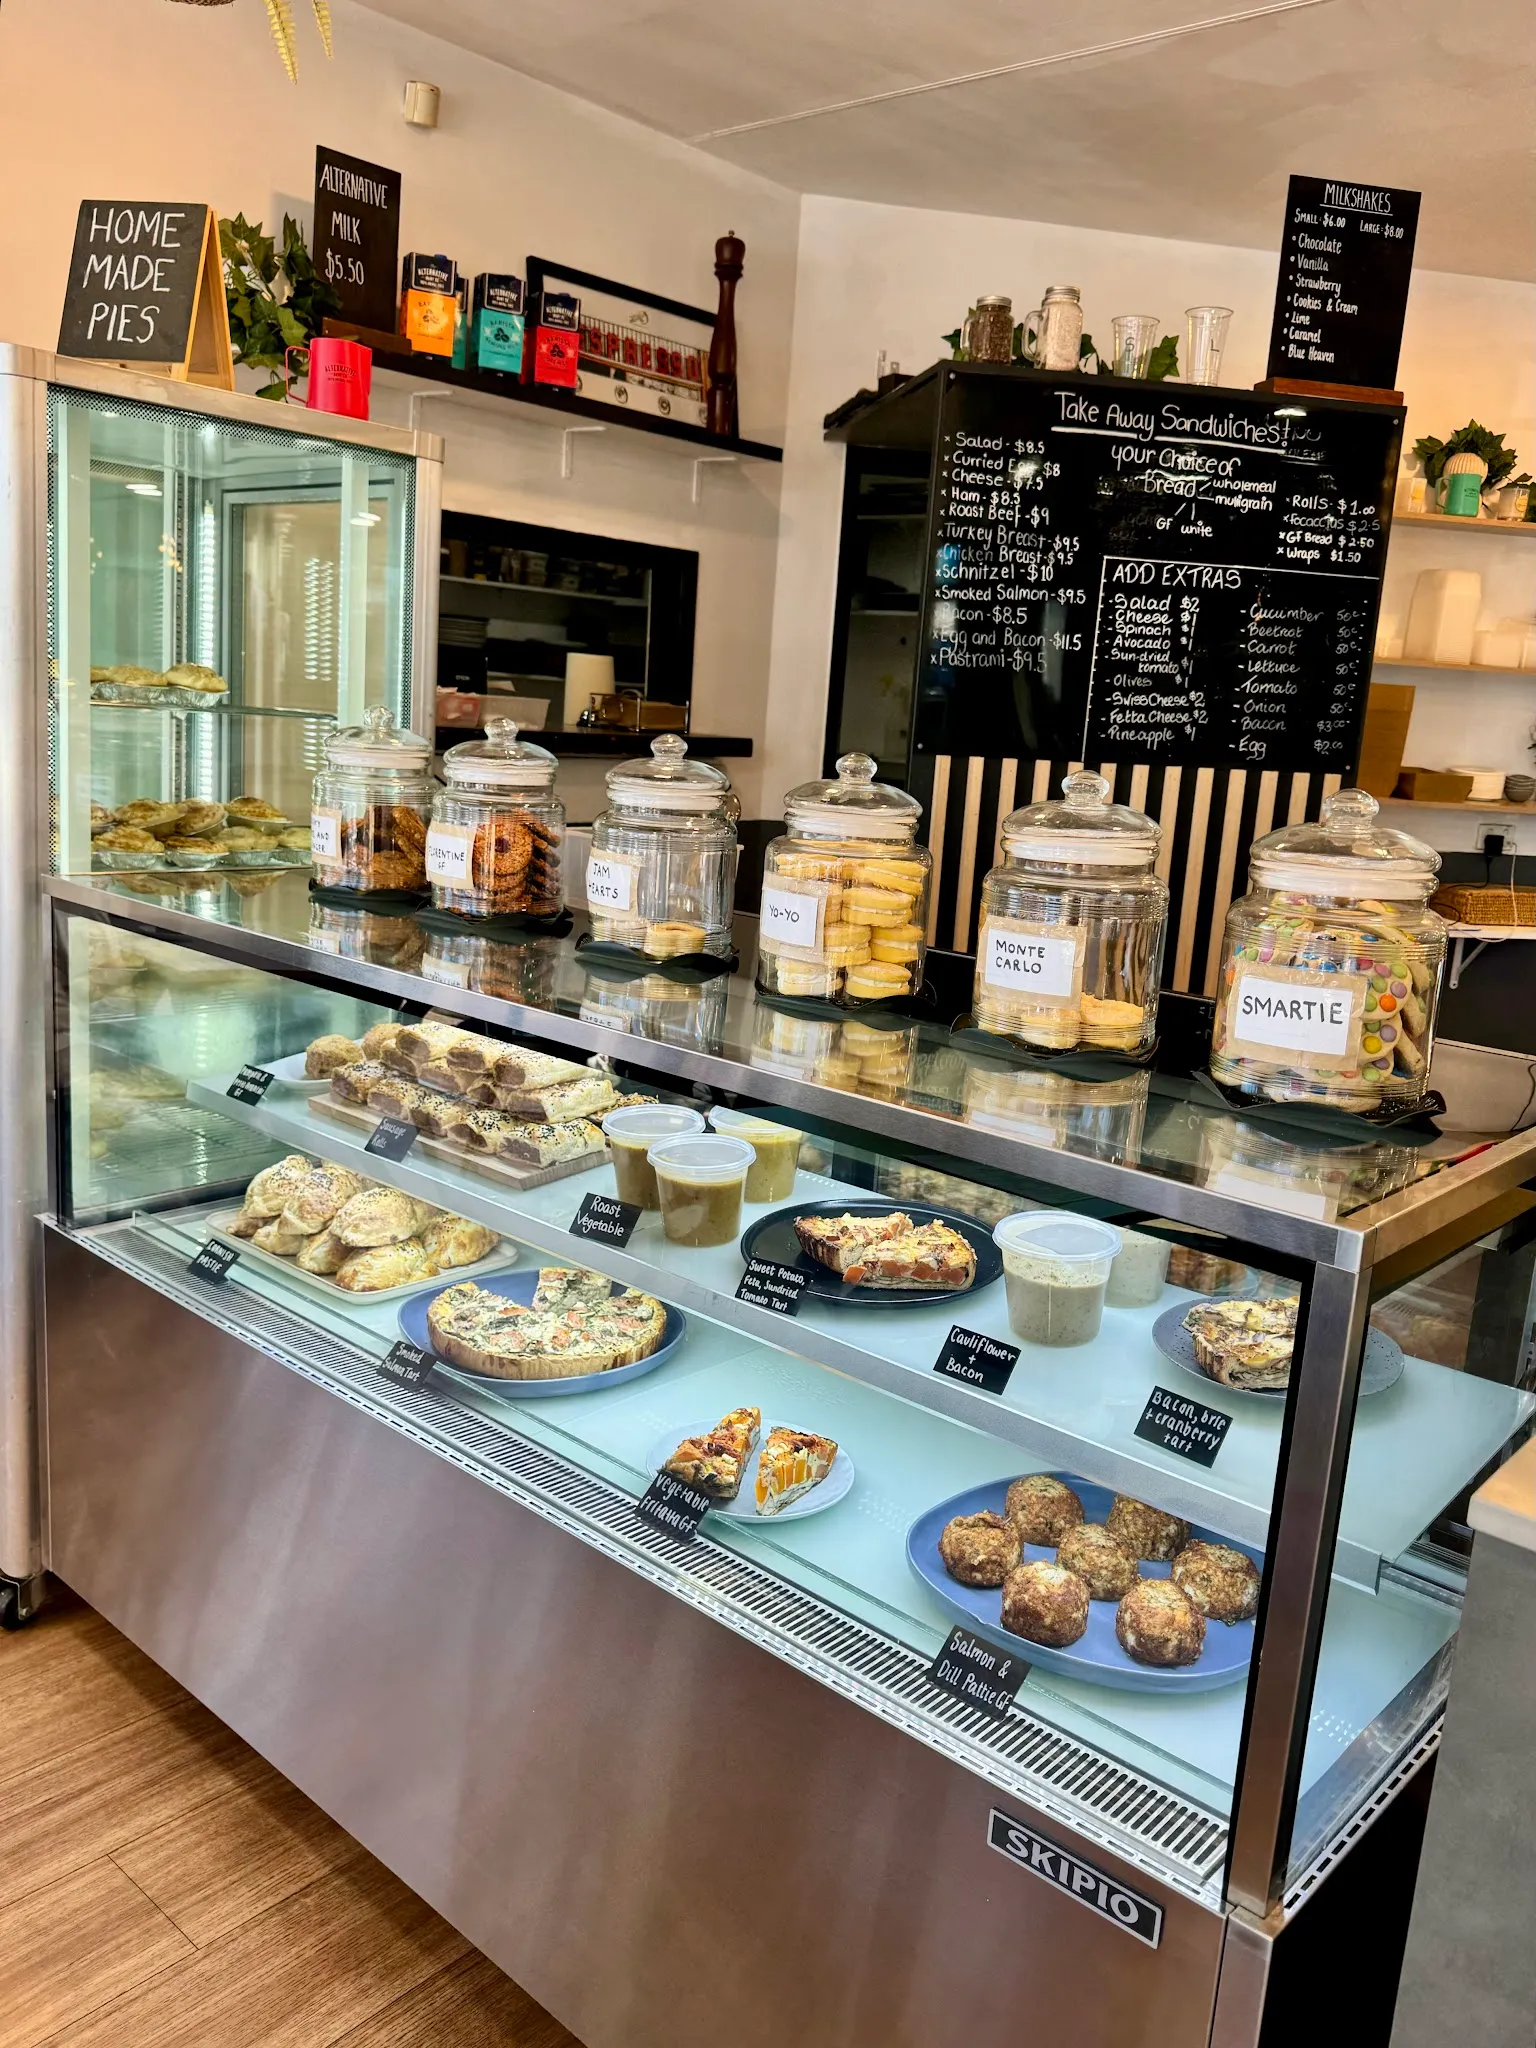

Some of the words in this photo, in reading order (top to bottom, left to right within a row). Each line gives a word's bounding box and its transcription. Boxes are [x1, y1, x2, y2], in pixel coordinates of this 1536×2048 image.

[319, 163, 388, 209] ALTERNATIVE
[1324, 183, 1391, 213] MILKSHAKES
[89, 208, 186, 248] HOME
[331, 211, 362, 245] MILK
[1298, 233, 1342, 254] Chocolate
[82, 253, 176, 292] MADE
[324, 248, 364, 286] $5.50
[1297, 254, 1329, 271] Vanilla
[1295, 274, 1341, 298] Strawberry
[1293, 293, 1322, 310] Cookies
[1326, 301, 1333, 312] &
[1335, 299, 1358, 315] Cream
[87, 302, 160, 344] PIES
[1291, 311, 1310, 325] Lime
[1125, 336, 1135, 351] S
[1289, 326, 1321, 343] Caramel
[1210, 338, 1220, 353] L
[1288, 344, 1305, 359] Blue
[1308, 346, 1334, 363] Heaven
[1054, 391, 1100, 423] Take
[1106, 404, 1155, 442] Away
[1161, 404, 1291, 447] Sandwiches!
[956, 432, 1003, 451] Salad
[1014, 439, 1045, 455] $8.5
[952, 451, 1004, 470] Curried
[1043, 461, 1061, 479] $8
[1111, 445, 1156, 471] your
[1159, 448, 1217, 474] Choice
[1217, 457, 1241, 477] of
[951, 468, 1004, 487] Cheese
[1144, 470, 1196, 497] Bread
[1213, 479, 1277, 493] wholemeal
[951, 486, 981, 503] Ham
[990, 491, 1021, 507] $8.5
[949, 502, 985, 518] Roast
[988, 504, 1022, 528] Beef
[1156, 518, 1173, 530] GF
[944, 522, 993, 551] Turkey
[997, 524, 1047, 549] Breast
[1286, 531, 1302, 544] GF
[1305, 532, 1332, 545] Bread
[943, 543, 993, 561] Chicken
[999, 545, 1042, 564] Breast
[1286, 547, 1320, 565] Wraps
[1330, 549, 1361, 563] $1.50
[943, 563, 1015, 580] Schnitzel
[1112, 562, 1155, 585] ADD
[1162, 564, 1241, 589] EXTRAS
[942, 585, 992, 600] Smoked
[997, 584, 1049, 601] Salmon
[1114, 593, 1172, 611] Salad
[1180, 596, 1200, 613] $2
[1115, 609, 1173, 624] Cheese
[1250, 603, 1325, 622] Cucumber
[941, 625, 968, 654] Egg
[972, 630, 996, 646] and
[1004, 627, 1046, 647] Bacon
[1115, 621, 1172, 638] Spinach
[1113, 634, 1171, 650] Avocado
[1247, 640, 1297, 655] Carrot
[940, 647, 1005, 668] Pastrami
[1111, 648, 1170, 662] Sun-dried
[1138, 661, 1179, 674] tomato
[1113, 674, 1152, 687] Olives
[1241, 675, 1298, 695] Tomato
[1243, 699, 1286, 714] Onion
[1241, 716, 1286, 732] Bacon
[1107, 725, 1175, 750] Pineapple
[1239, 734, 1267, 761] Egg
[593, 863, 611, 878] JAM
[768, 904, 800, 923] YO-YO
[996, 939, 1045, 959] MONTE
[996, 957, 1042, 975] CARLO
[1242, 995, 1344, 1025] SMARTIE
[590, 1196, 621, 1218] Roast
[577, 1210, 624, 1237] Vegetable
[197, 1255, 222, 1273] PASTIE
[749, 1260, 776, 1277] Sweet
[778, 1268, 805, 1286] Potato,
[744, 1275, 761, 1290] Feta,
[764, 1280, 799, 1299] Sundried
[741, 1289, 769, 1305] Tomato
[772, 1298, 788, 1311] Tart
[396, 1344, 425, 1364] Smoked
[950, 1328, 1016, 1361] Cauliflower
[382, 1357, 406, 1377] Salmon
[404, 1367, 420, 1382] Tart
[946, 1357, 984, 1383] Bacon
[1152, 1391, 1198, 1424] Bacon,
[1201, 1410, 1227, 1430] brie
[1155, 1412, 1221, 1451] cranberry
[1164, 1433, 1193, 1452] tart
[656, 1474, 710, 1512] Vegetable
[679, 1515, 697, 1532] GF
[950, 1631, 996, 1670] Salmon
[998, 1660, 1012, 1679] &
[937, 1660, 962, 1686] Dill
[962, 1673, 997, 1704] Pattie
[996, 1691, 1013, 1710] GF
[1006, 1829, 1139, 1924] SKIPIO
